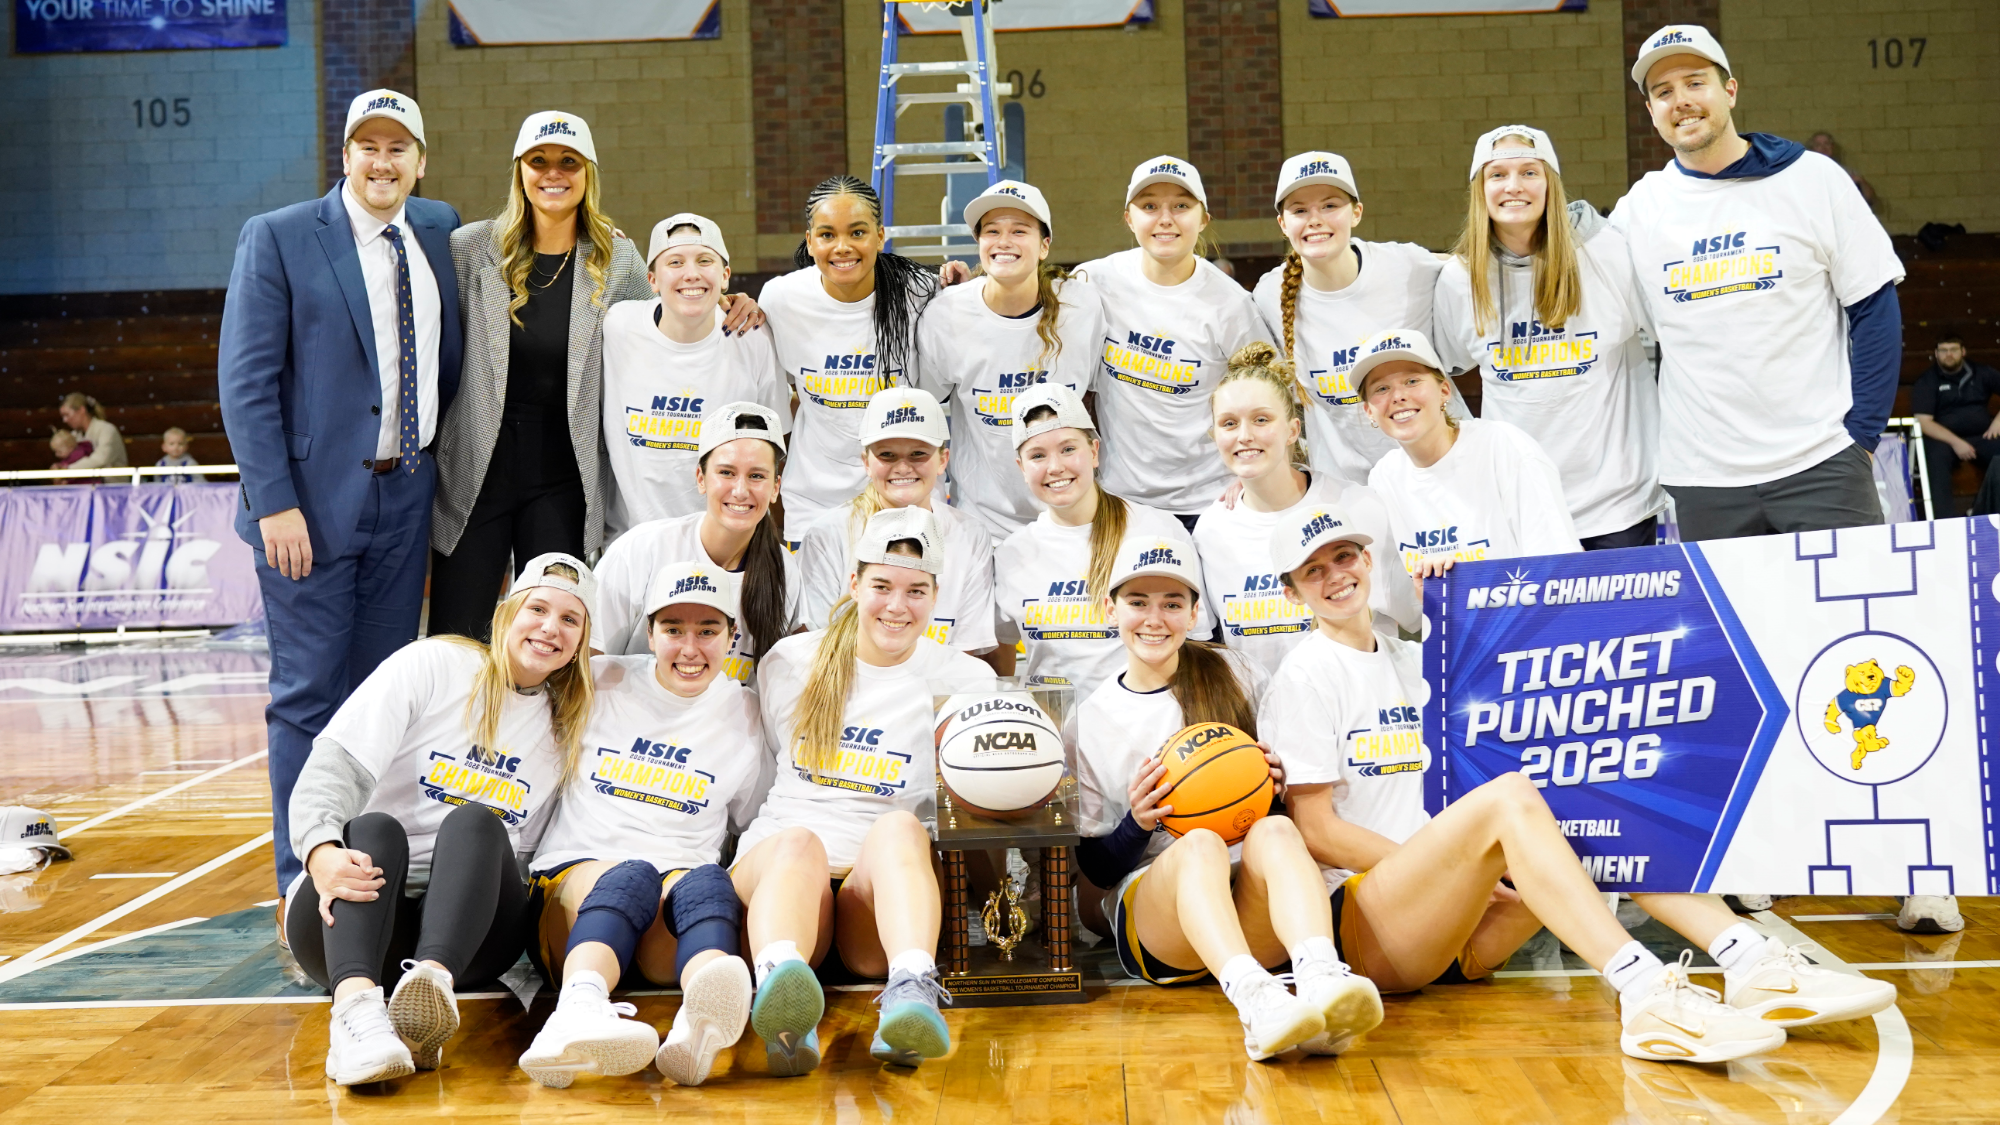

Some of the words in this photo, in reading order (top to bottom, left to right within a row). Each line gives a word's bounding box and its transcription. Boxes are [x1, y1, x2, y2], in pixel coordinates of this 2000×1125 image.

[26, 0, 94, 20] YOUR
[104, 0, 153, 18] TIME
[163, 0, 194, 18] TO
[201, 0, 275, 17] SHINE
[1867, 38, 1926, 69] 107
[1006, 69, 1046, 99] 06
[362, 102, 406, 116] CHAMPIONS
[368, 97, 398, 108] NSIC
[132, 97, 190, 129] 105
[534, 127, 577, 141] CHAMPIONS
[540, 121, 569, 133] NSIC
[1300, 160, 1329, 173] NSIC
[1692, 231, 1746, 256] NSIC
[1709, 248, 1745, 259] TOURNAMENT
[1670, 254, 1773, 288] CHAMPIONS
[1691, 289, 1720, 299] WOMEN'S
[1720, 283, 1756, 294] BASKETBALL
[1128, 330, 1175, 354] NSIC
[1530, 334, 1566, 343] OURNAMENT
[824, 354, 876, 369] NSIC
[1127, 344, 1139, 352] 2026
[1141, 348, 1172, 361] TOURNAMENT
[1333, 346, 1360, 366] NS
[1494, 339, 1592, 367] CHAMPIONS
[1105, 345, 1194, 382] CHAMPIONS
[999, 370, 1049, 388] NSIC
[1117, 374, 1141, 385] WOMEN'S
[1142, 380, 1175, 393] BASKETBALL
[1513, 371, 1539, 380] WOMEN'S
[1541, 368, 1577, 378] BASKETBALL
[651, 396, 704, 412] NSIC
[886, 406, 918, 421] NSIC
[629, 414, 702, 438] CHAMPIO
[880, 416, 925, 429] CHAMPIONS
[645, 441, 671, 449] WOMEN'S
[1300, 519, 1343, 548] CHAMPIONS
[1301, 513, 1333, 536] NSIC
[1415, 526, 1458, 547] NSIC
[1139, 548, 1173, 564] NSIC
[1430, 544, 1459, 553] TOURNAMENT
[28, 540, 223, 592] NSIC
[1132, 558, 1181, 571] CHAMPIONS
[668, 583, 718, 598] CHAMPIONS
[676, 576, 709, 591] NSIC
[1048, 580, 1091, 596] NSI
[1244, 574, 1286, 591] NSI
[1466, 583, 1541, 609] NSIC
[1543, 570, 1682, 605] CHAMPIONS
[1243, 627, 1268, 635] WOMEN'S
[1269, 624, 1301, 633] BASKETBALL
[1497, 630, 1685, 694] TICKET
[960, 699, 1042, 721] Wilson
[1379, 706, 1420, 725] NSIC
[1465, 676, 1717, 747] PUNCHED
[841, 726, 884, 745] SIC
[973, 732, 1037, 753] NCAA
[1177, 726, 1234, 762] NCAA
[631, 737, 692, 763] NSIC
[1356, 732, 1422, 759] CHAMPI
[466, 744, 522, 773] NSIC
[629, 753, 645, 761] 2026
[647, 757, 685, 770] TOURNAMENT
[1520, 733, 1662, 789] 2026
[464, 760, 480, 770] 2026
[481, 765, 513, 779] TOURNAMENT
[598, 756, 708, 799] CHAMPIONS
[1380, 763, 1408, 774] WOMEN'S
[429, 761, 525, 810] CHAMPIONS
[839, 779, 876, 793] BASKETBALL
[614, 788, 645, 800] WOMEN'S
[645, 796, 684, 810] BASKETBALL
[26, 822, 50, 833] NSIC
[1556, 819, 1621, 837] KETBALL
